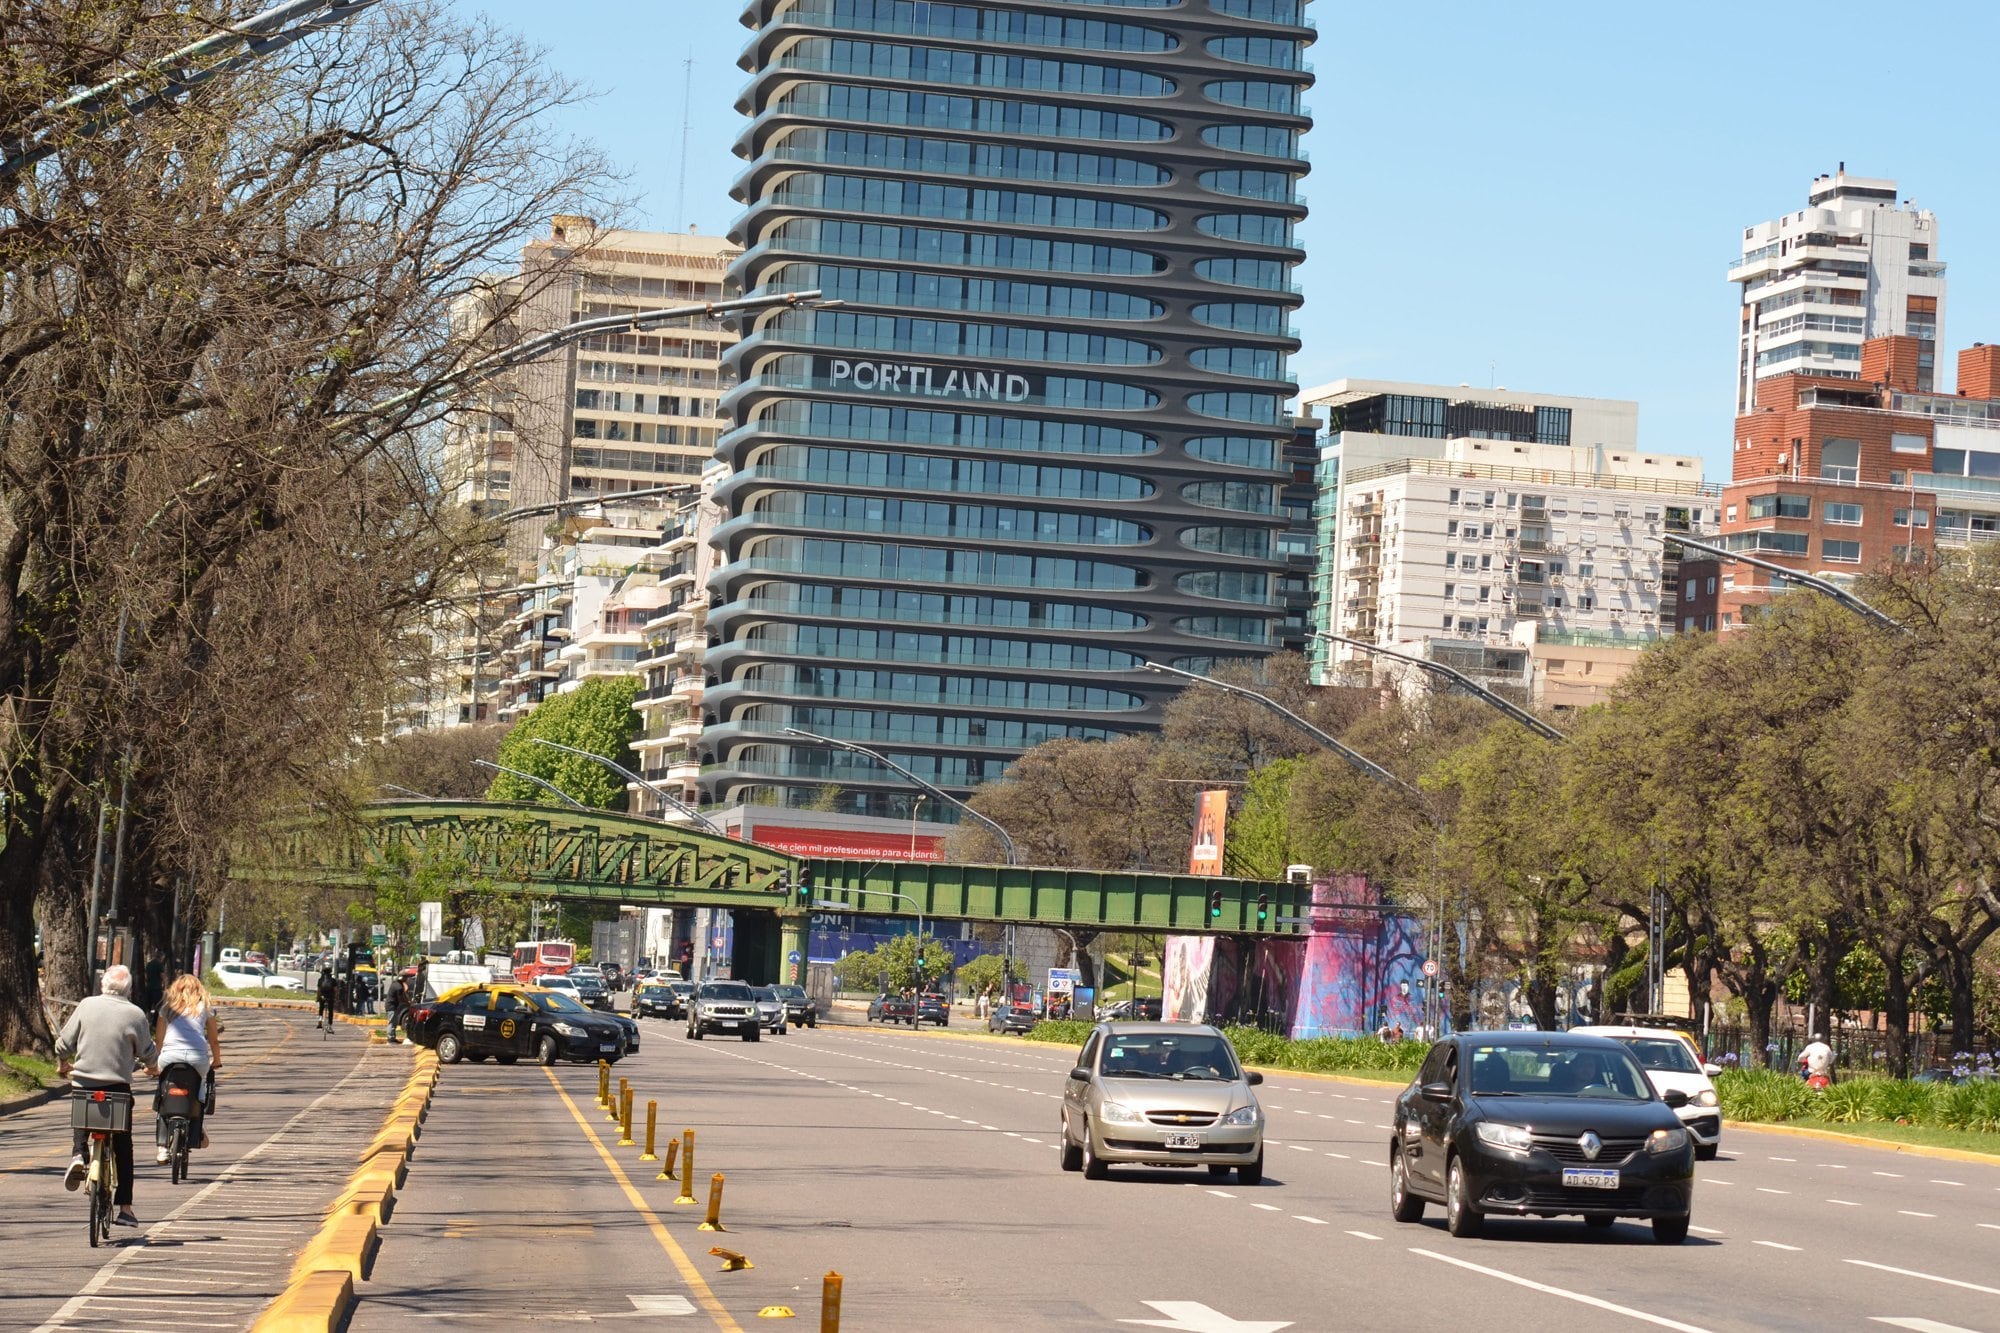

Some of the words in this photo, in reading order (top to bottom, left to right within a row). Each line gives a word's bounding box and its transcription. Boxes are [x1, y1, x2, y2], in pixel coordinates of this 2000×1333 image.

[831, 359, 1030, 402] PORTLAND
[789, 844, 807, 852] cien
[808, 845, 822, 853] mil
[823, 846, 880, 856] profesionales
[882, 849, 901, 857] para
[1184, 1137, 1198, 1146] 202
[1566, 1176, 1579, 1185] AD
[1582, 1176, 1600, 1185] 457
[1603, 1177, 1617, 1187] PS
